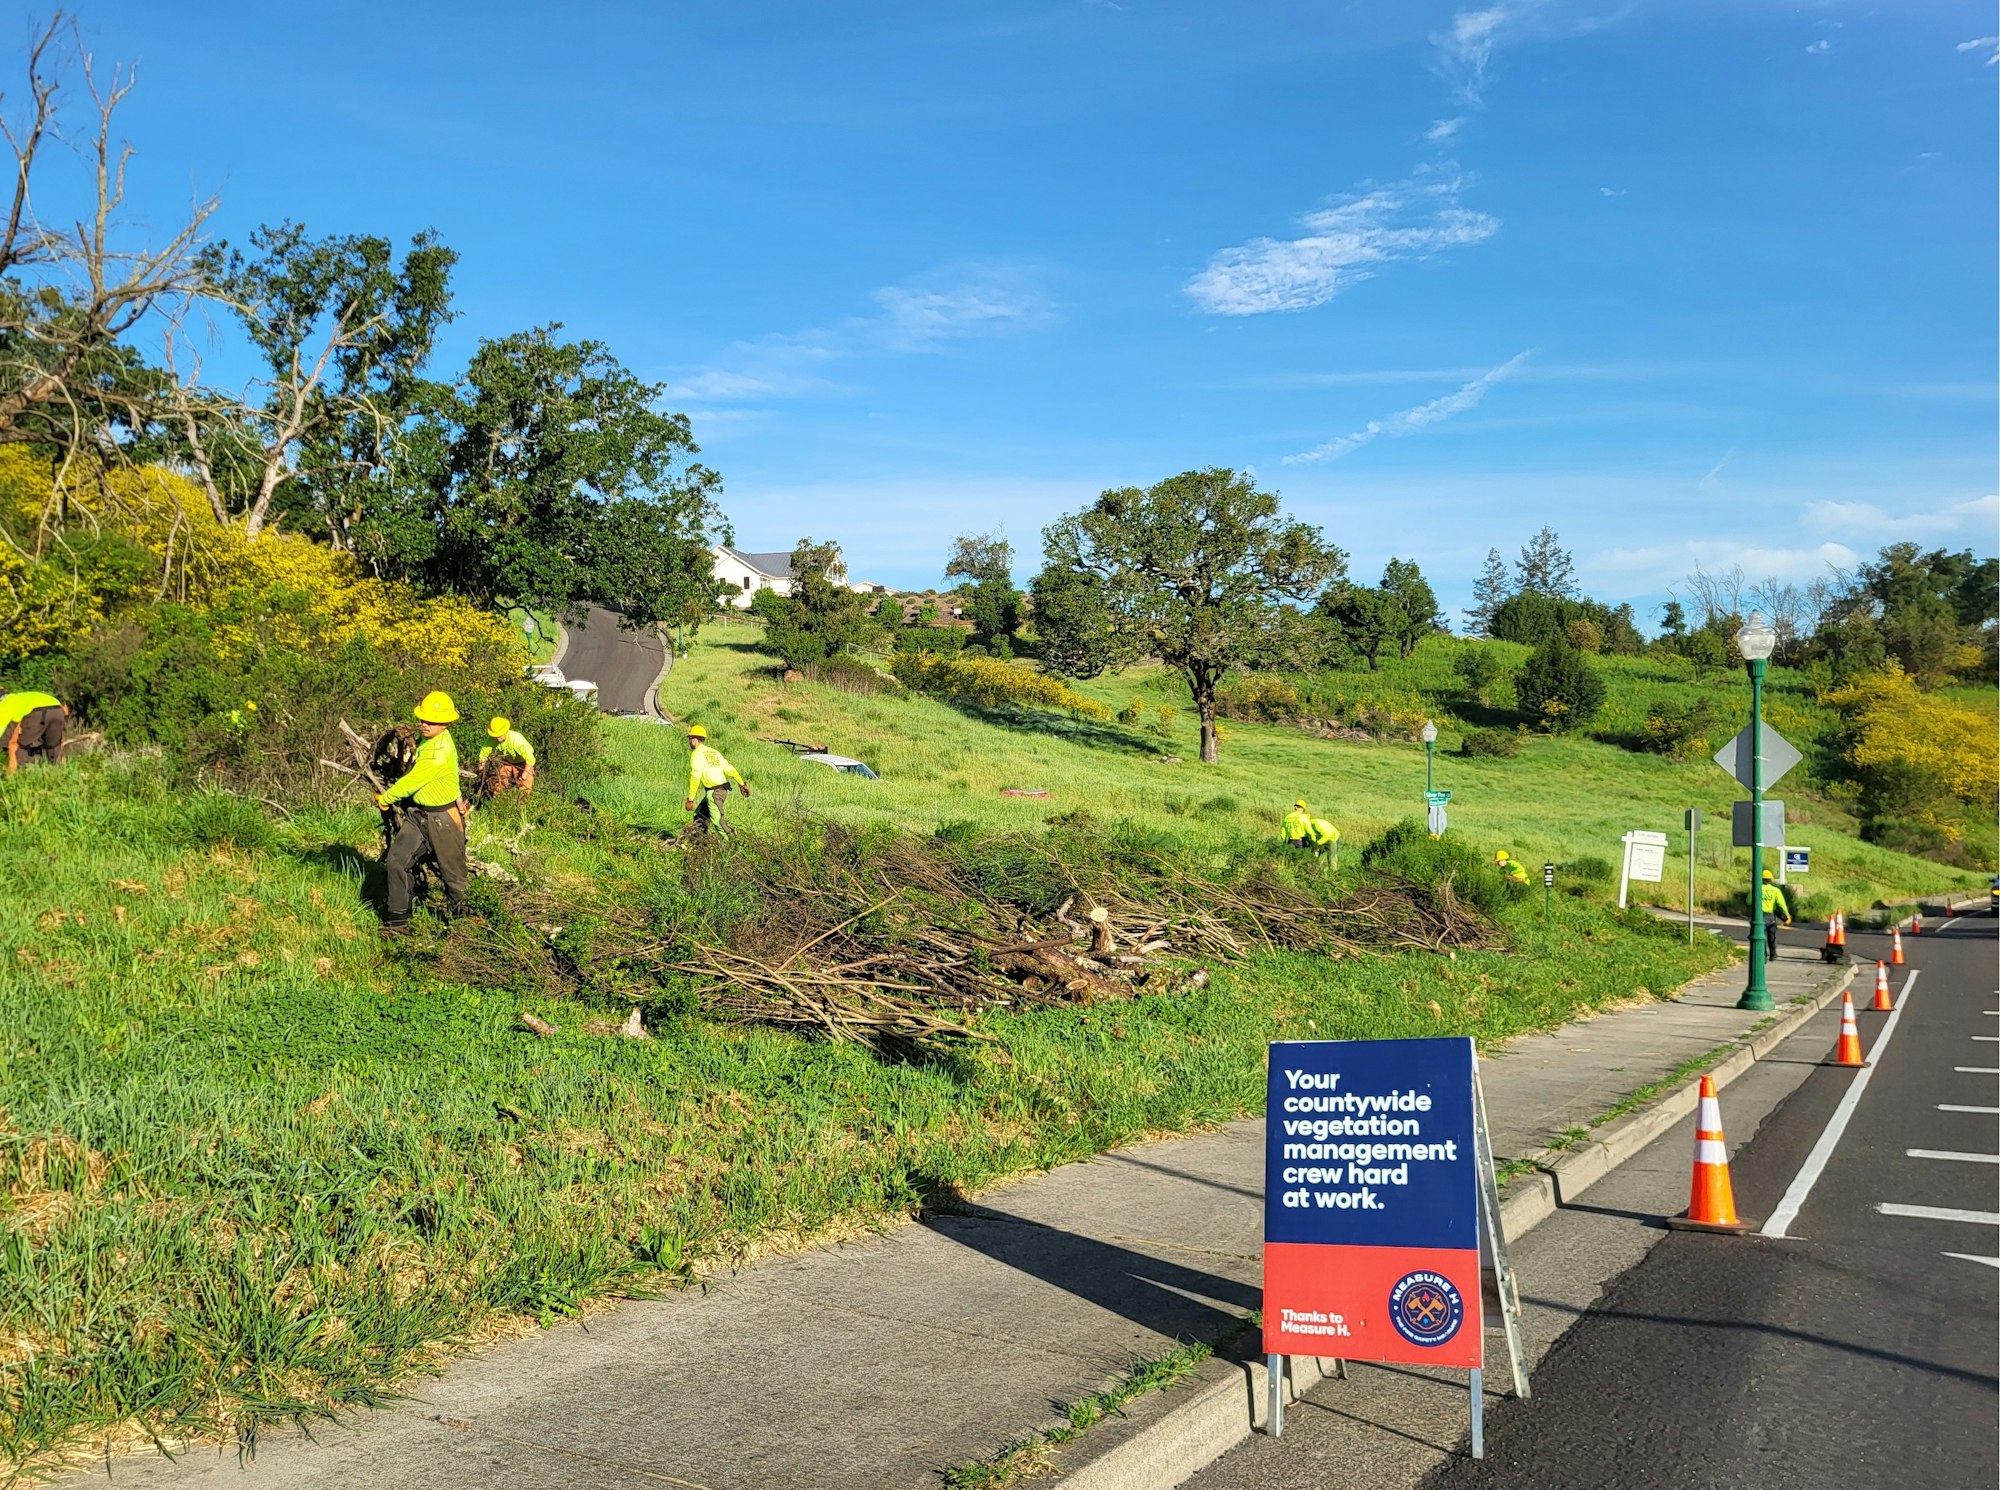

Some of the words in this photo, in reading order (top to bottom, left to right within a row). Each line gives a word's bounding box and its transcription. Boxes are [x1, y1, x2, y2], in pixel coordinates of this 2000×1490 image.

[1285, 1070, 1340, 1090] Your
[1284, 1090, 1432, 1117] countywide
[1283, 1114, 1420, 1141] vegetation
[1283, 1140, 1457, 1165] management
[1283, 1166, 1343, 1184] crew
[1348, 1162, 1408, 1185] hard
[1283, 1188, 1309, 1208] at
[1314, 1187, 1385, 1209] work.
[1393, 1274, 1450, 1301] MEASURE
[1449, 1293, 1460, 1304] H
[1281, 1309, 1327, 1323] Thanks
[1329, 1312, 1343, 1324] to
[1281, 1321, 1336, 1335] Measure
[1337, 1324, 1351, 1337] H.
